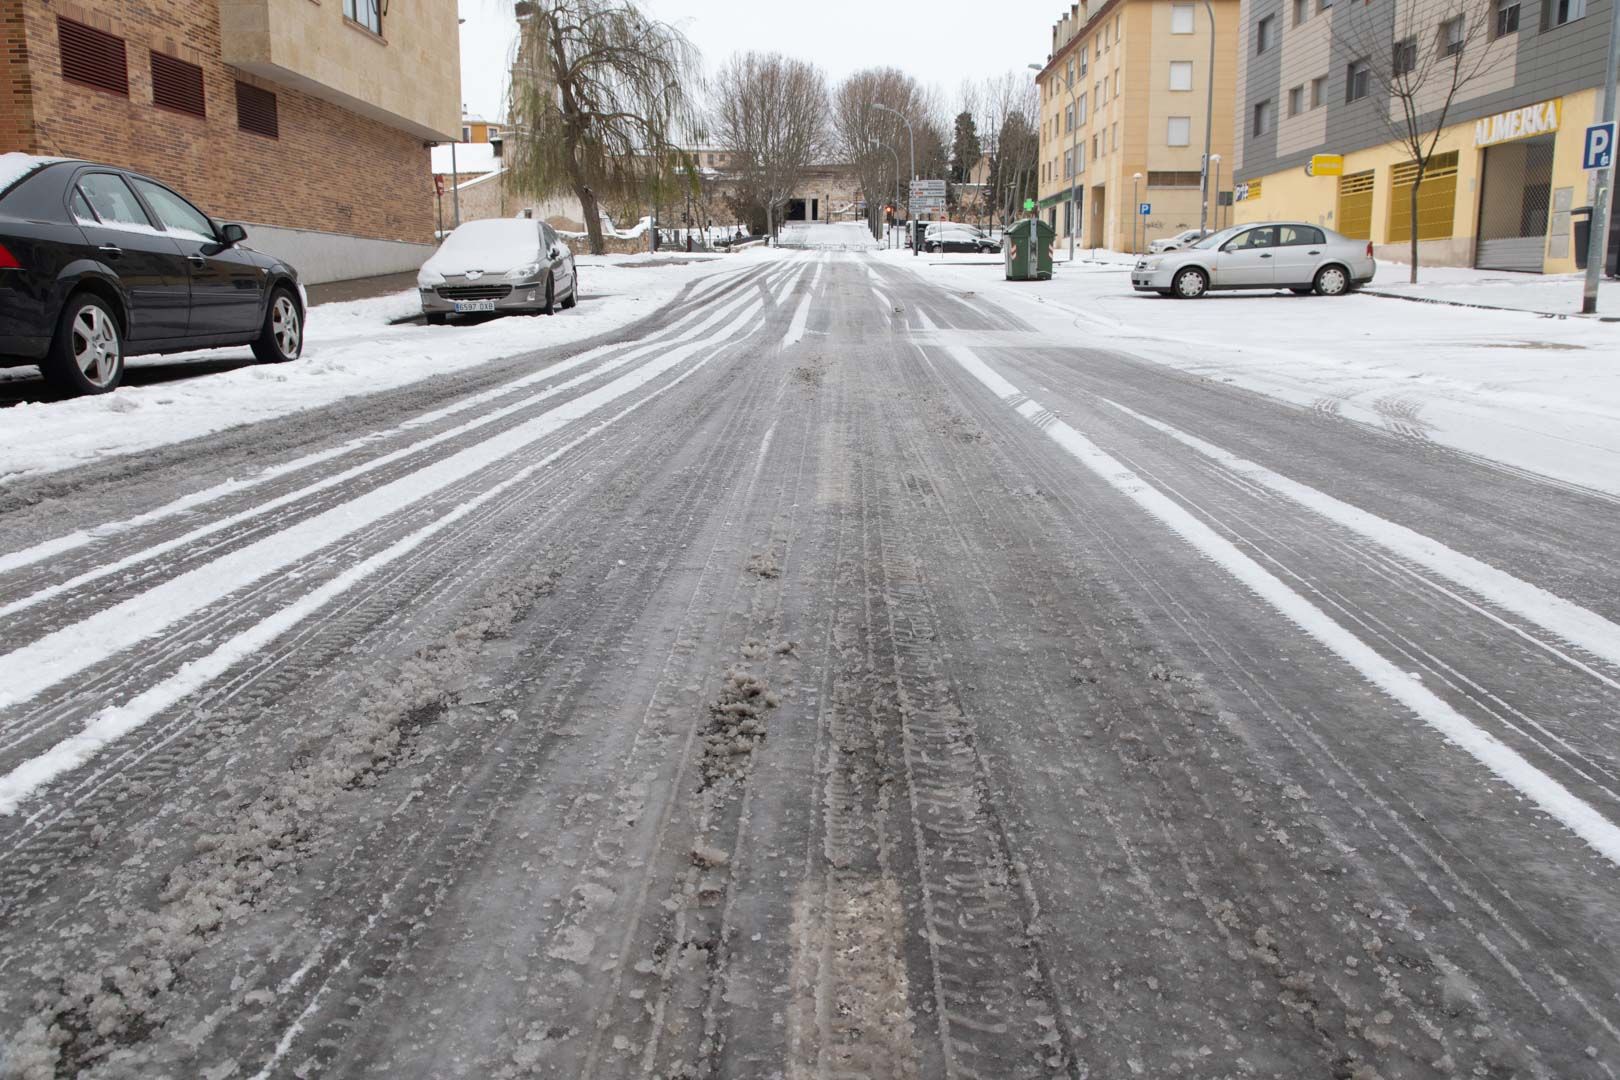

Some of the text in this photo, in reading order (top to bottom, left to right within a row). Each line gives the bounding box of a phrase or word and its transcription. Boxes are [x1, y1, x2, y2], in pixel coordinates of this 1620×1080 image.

[1475, 100, 1558, 145] ALIMERKA
[1588, 128, 1609, 166] P
[1141, 204, 1149, 214] P
